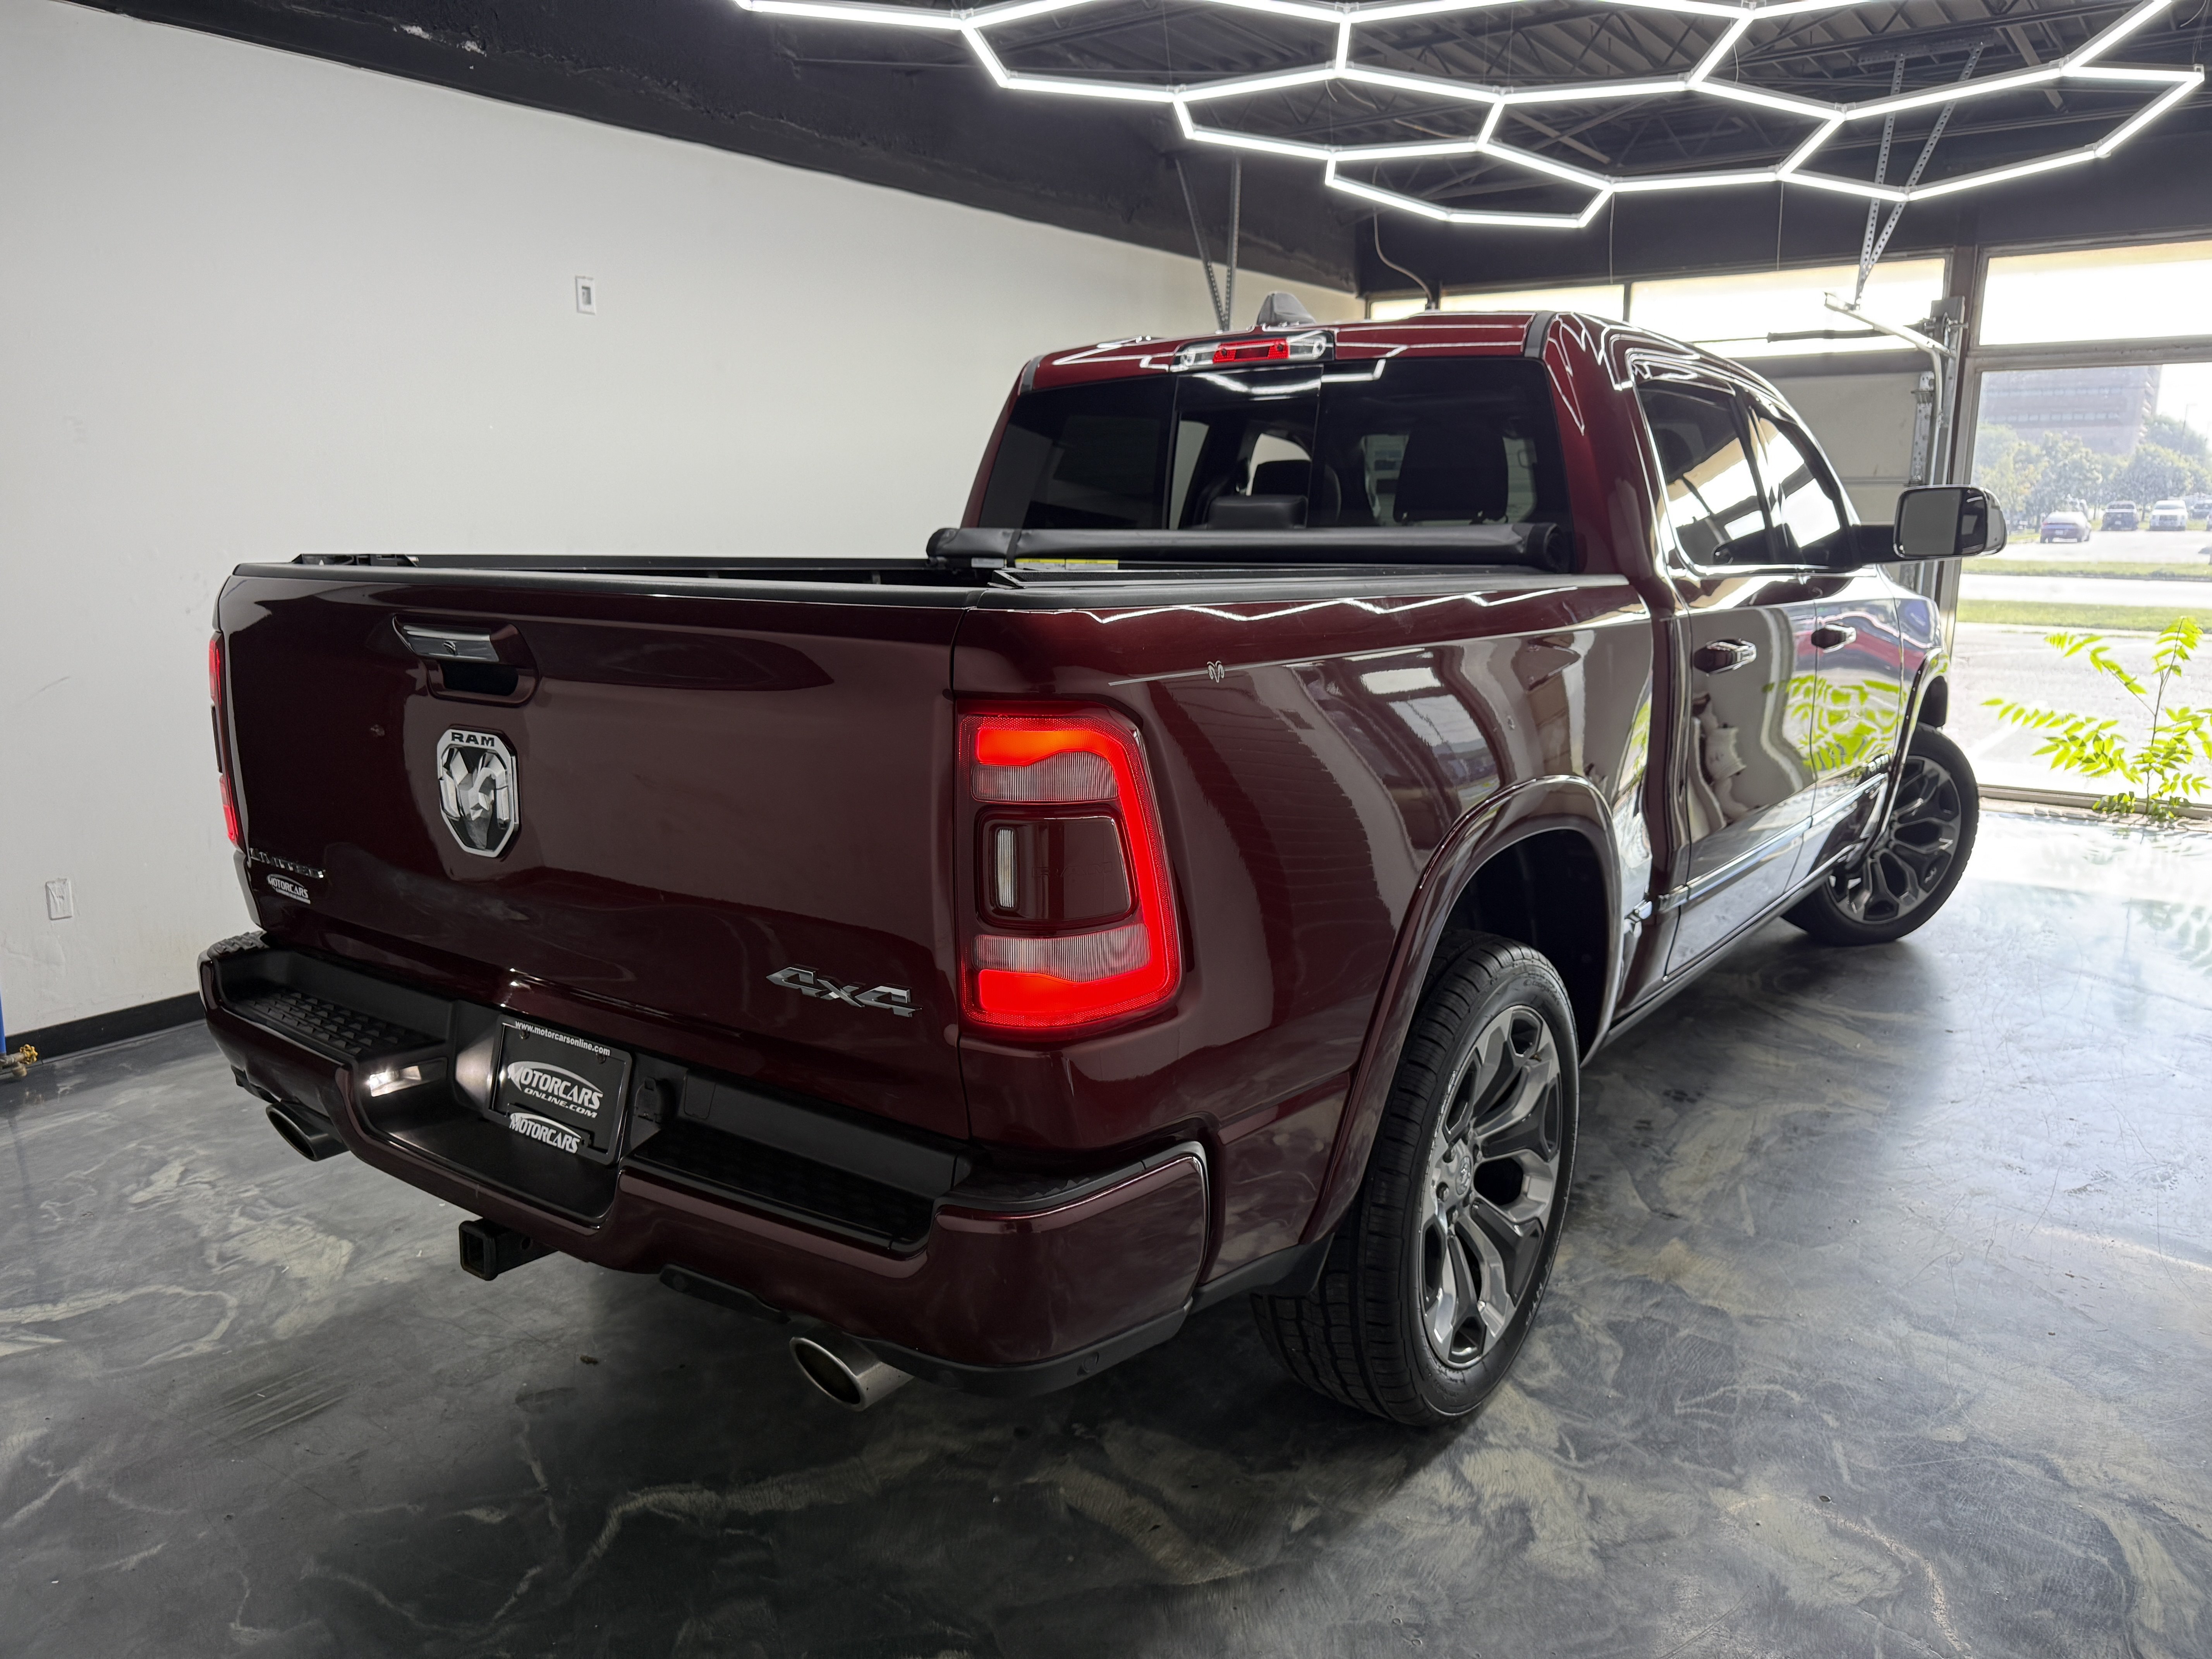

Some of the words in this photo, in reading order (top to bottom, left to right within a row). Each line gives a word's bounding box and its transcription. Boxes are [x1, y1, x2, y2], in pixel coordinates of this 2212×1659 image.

[451, 732, 495, 747] RAM
[267, 876, 309, 899] MOTORCARS
[515, 1020, 611, 1056] www.motorcarsonline.com
[507, 1063, 603, 1110] MOTORCARS
[524, 1087, 598, 1118] ONLINE.COM
[509, 1116, 580, 1154] MOTORCARS
